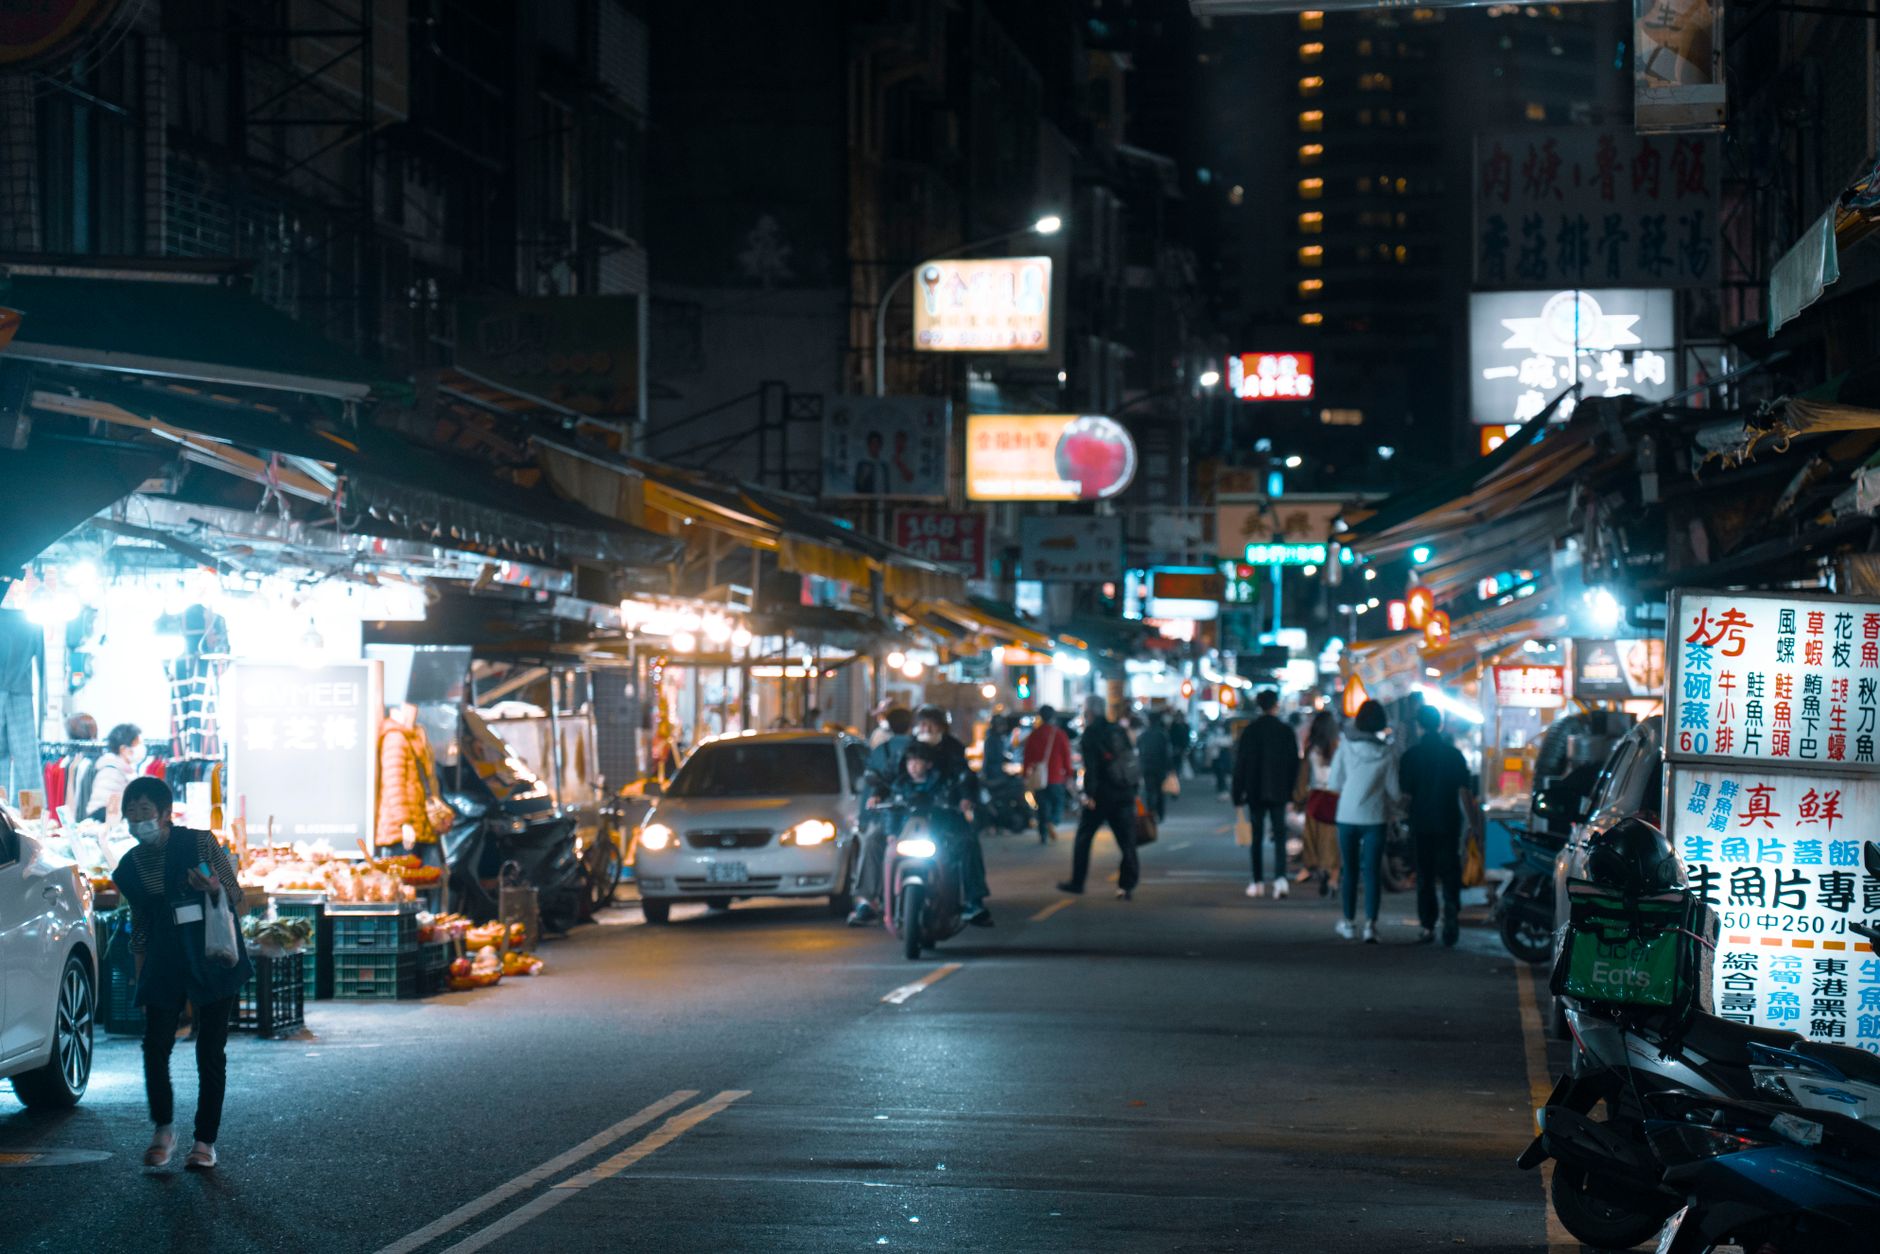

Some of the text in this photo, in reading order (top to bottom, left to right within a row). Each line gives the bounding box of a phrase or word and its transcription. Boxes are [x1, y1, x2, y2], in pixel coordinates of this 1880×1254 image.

[1686, 607, 1754, 657] 烤
[1776, 608, 1797, 664] 風螺
[1804, 611, 1826, 667] 草蝦
[1832, 612, 1854, 668] 花枝
[1860, 613, 1880, 669] 香魚
[1680, 642, 1714, 755] 茶碗蒸 60
[1714, 669, 1736, 753] 牛小排
[1743, 671, 1765, 756] 鮭魚片
[1771, 672, 1793, 758] 鮭魚頭
[1800, 673, 1823, 759] 鮪魚下巴
[1855, 677, 1878, 762] 秋刀魚
[1687, 780, 1712, 816] 頂級
[1707, 780, 1740, 833] 鮮魚湯
[1738, 782, 1843, 832] 真鮮
[1684, 835, 1880, 867] 生魚片蓋飯
[1592, 960, 1652, 988] Eats
[1809, 958, 1848, 1045] 東港黑鮪
